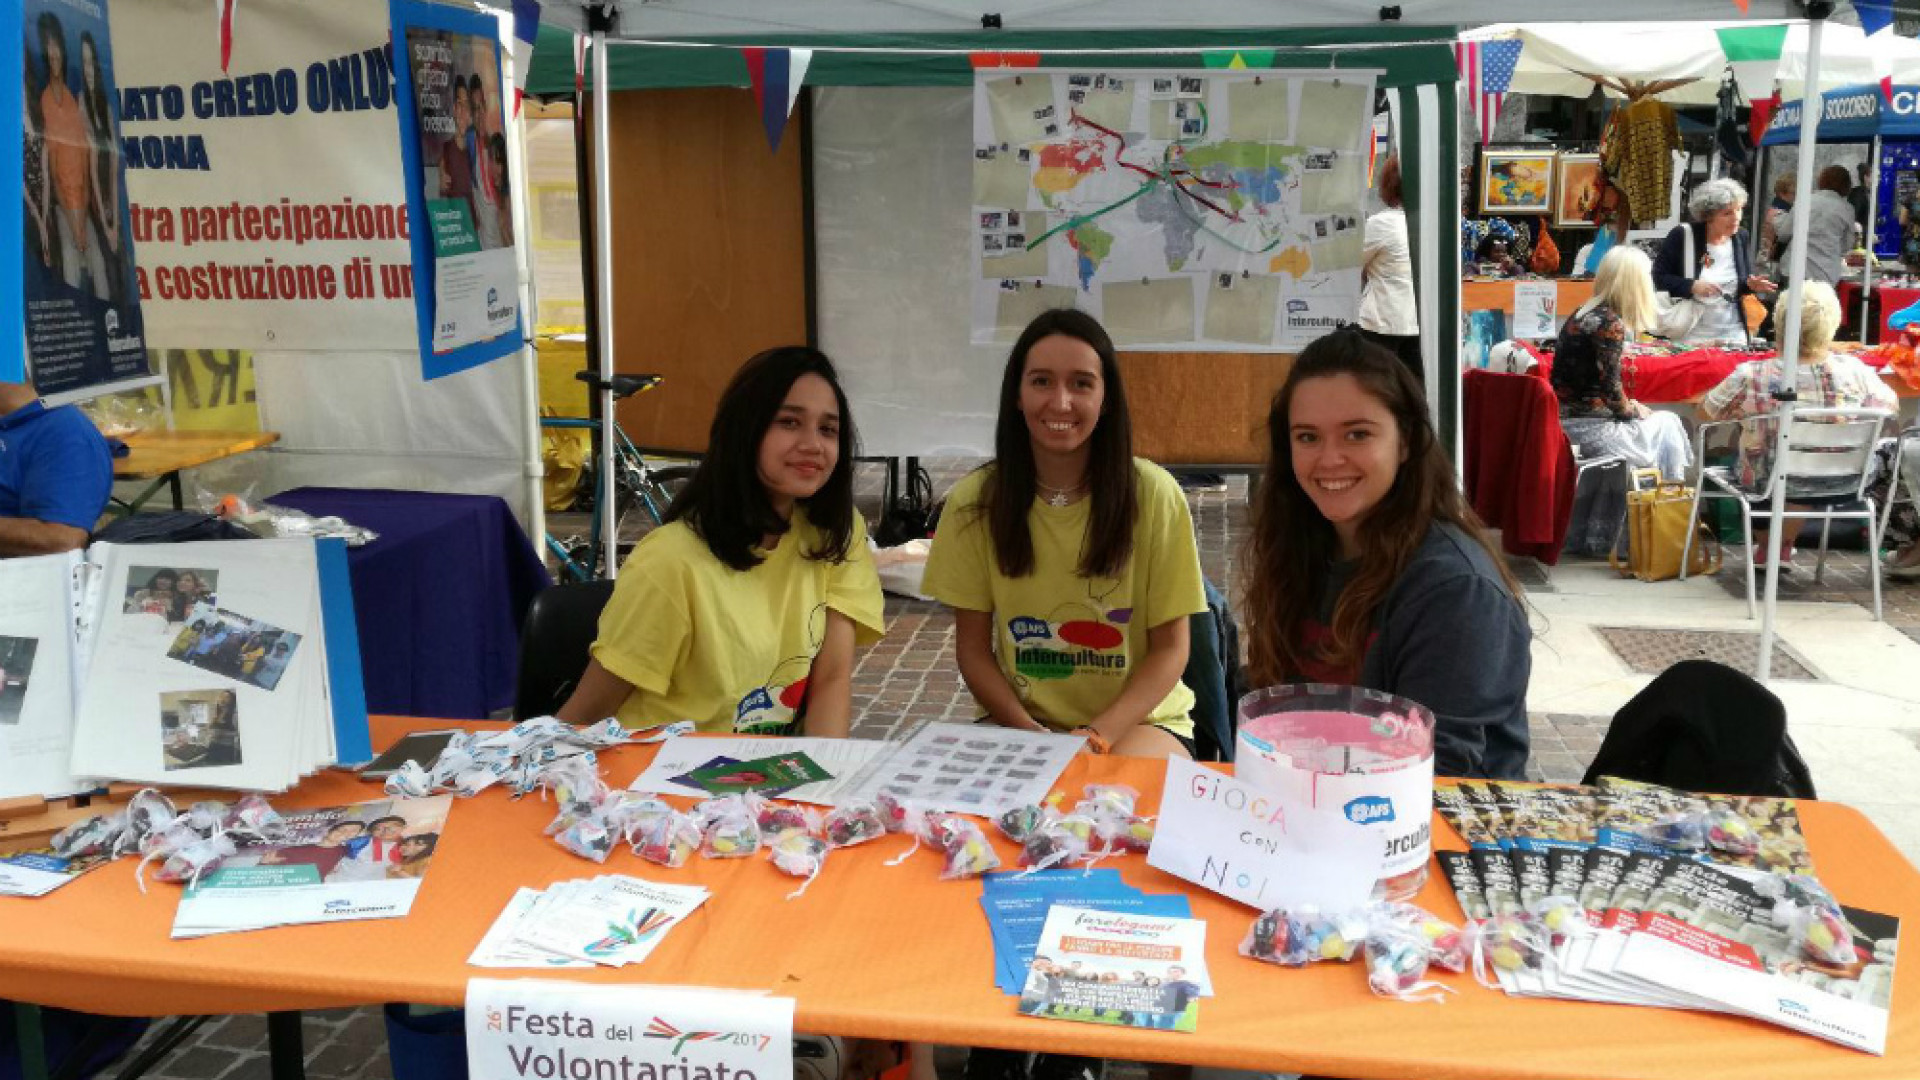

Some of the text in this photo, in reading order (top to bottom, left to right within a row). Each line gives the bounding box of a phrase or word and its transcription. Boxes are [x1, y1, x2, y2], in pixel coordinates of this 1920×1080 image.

[116, 85, 184, 121] ATO
[191, 67, 298, 120] CREDO
[1893, 91, 1920, 114] C
[180, 197, 411, 246] partecipazione
[155, 258, 337, 300] costruzione
[343, 257, 375, 298] di
[1016, 646, 1126, 669] Intercultura
[507, 1006, 594, 1039] Festa
[605, 1024, 634, 1041] del
[732, 1032, 772, 1052] 2017
